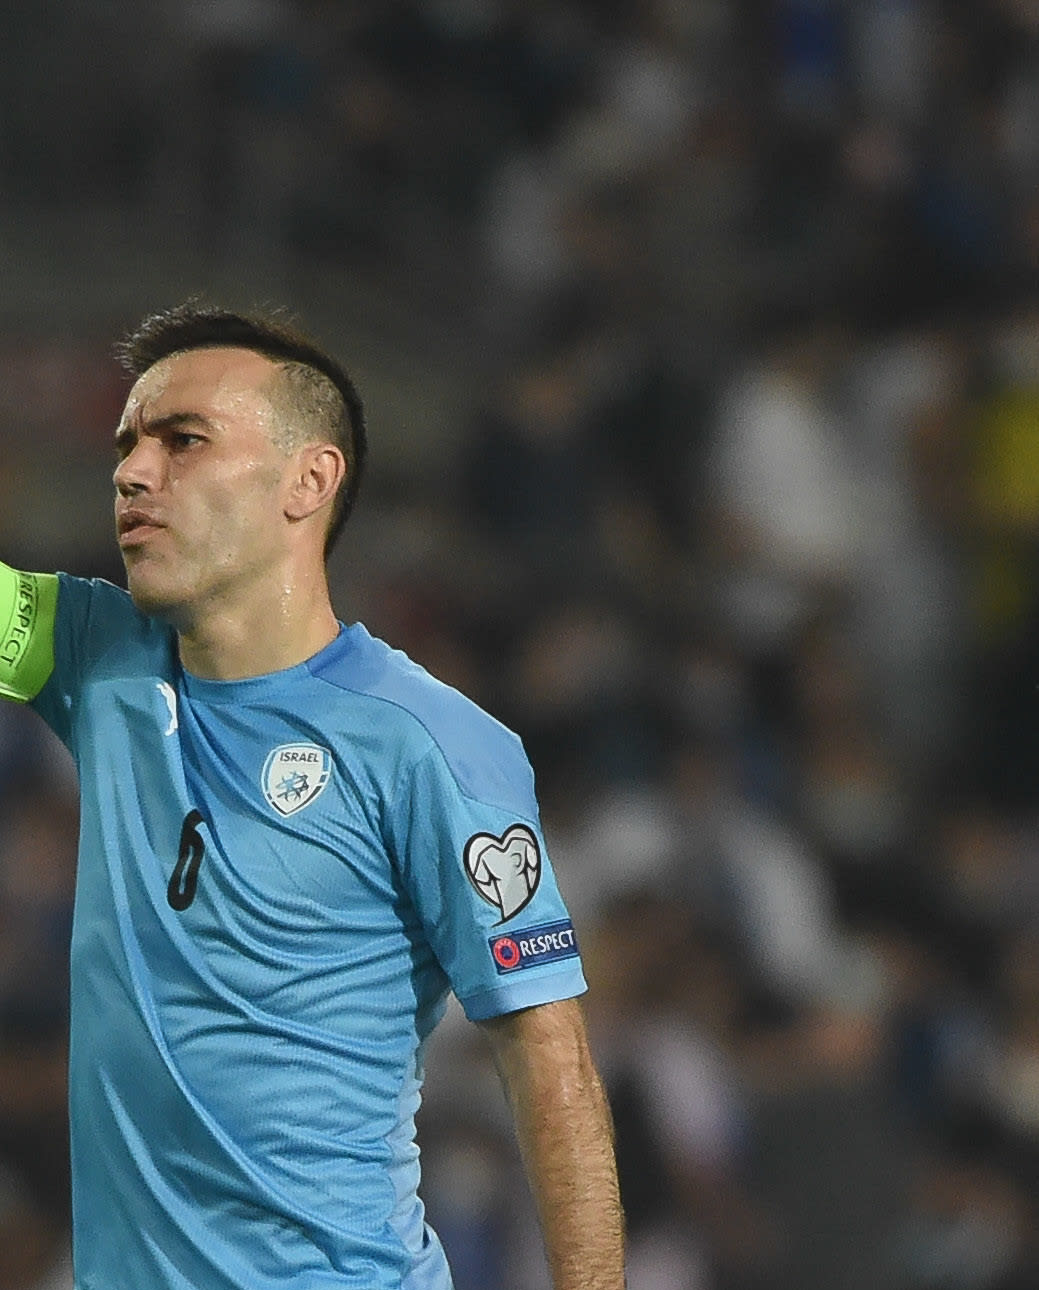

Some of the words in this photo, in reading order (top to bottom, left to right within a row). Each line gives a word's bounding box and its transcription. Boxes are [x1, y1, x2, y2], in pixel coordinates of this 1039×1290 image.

[0, 578, 34, 668] RESPECT
[280, 751, 319, 762] ISRAEL
[167, 808, 205, 911] 6
[519, 929, 575, 957] RESPECT
